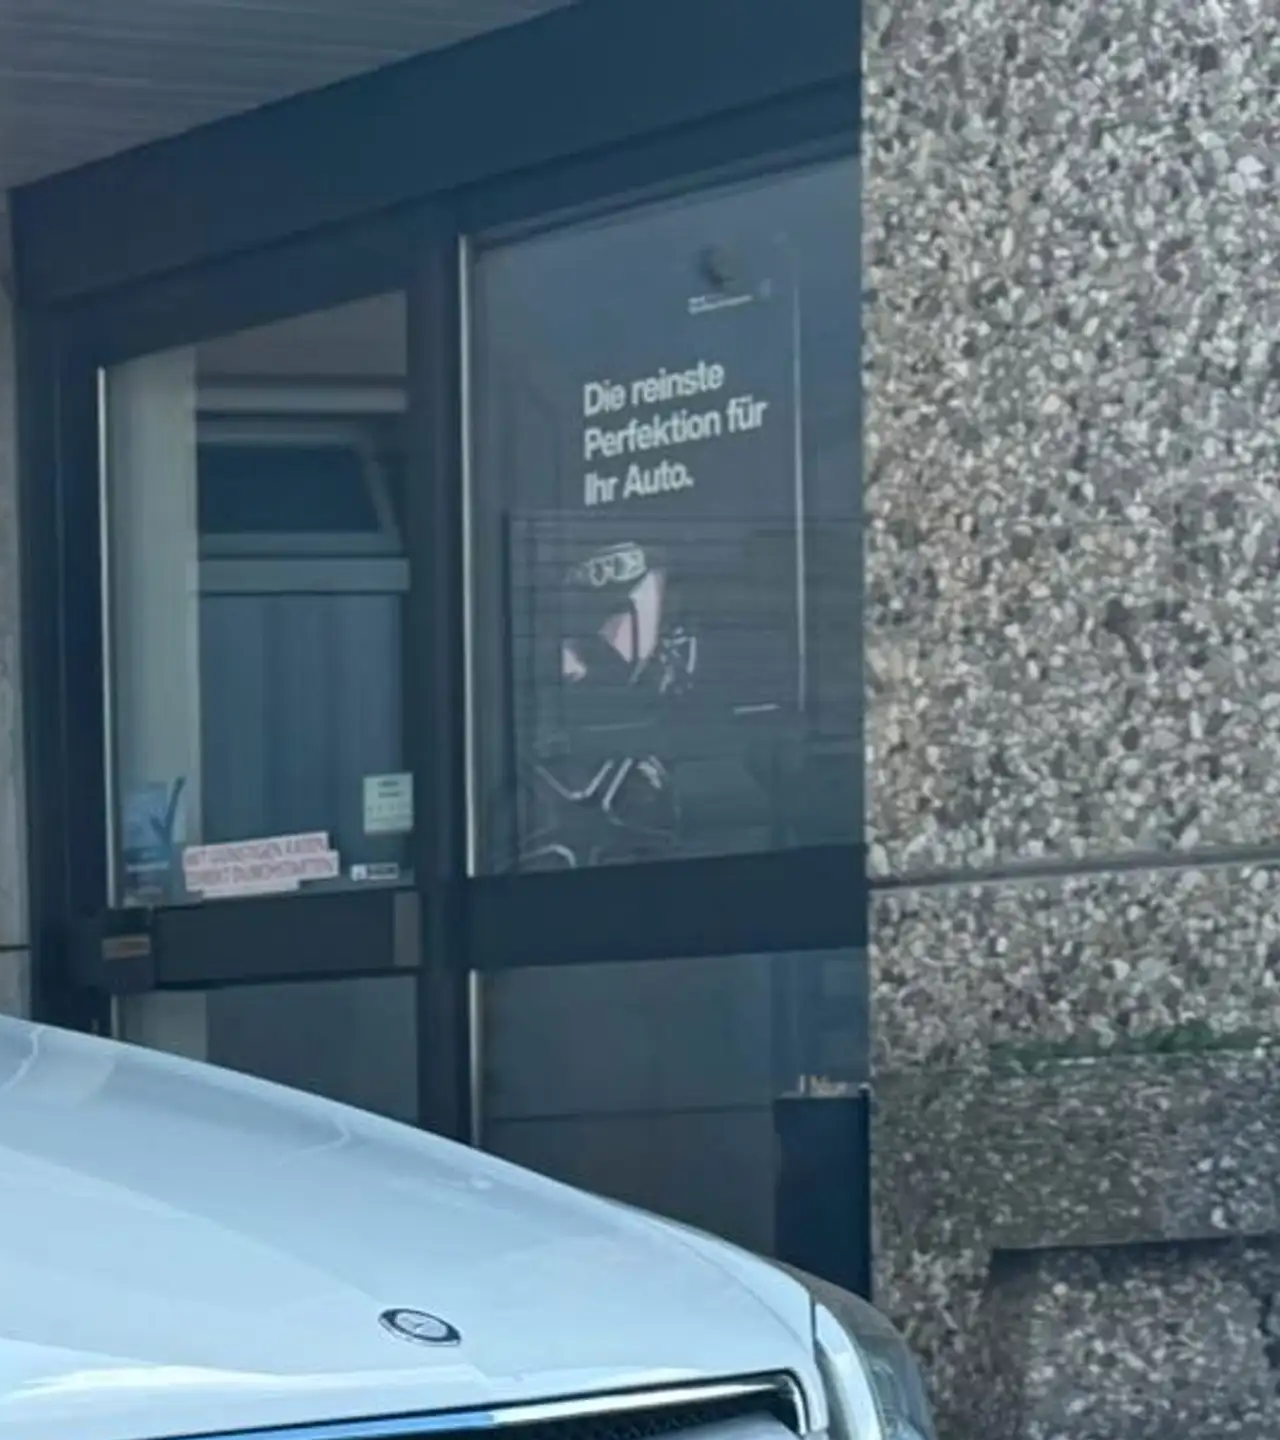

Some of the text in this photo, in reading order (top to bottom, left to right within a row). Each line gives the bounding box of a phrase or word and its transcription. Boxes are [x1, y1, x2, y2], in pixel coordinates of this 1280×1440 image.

[584, 360, 725, 417] Die reinste
[584, 394, 769, 461] Perfektion für
[584, 459, 694, 507] Ihr Auto.
